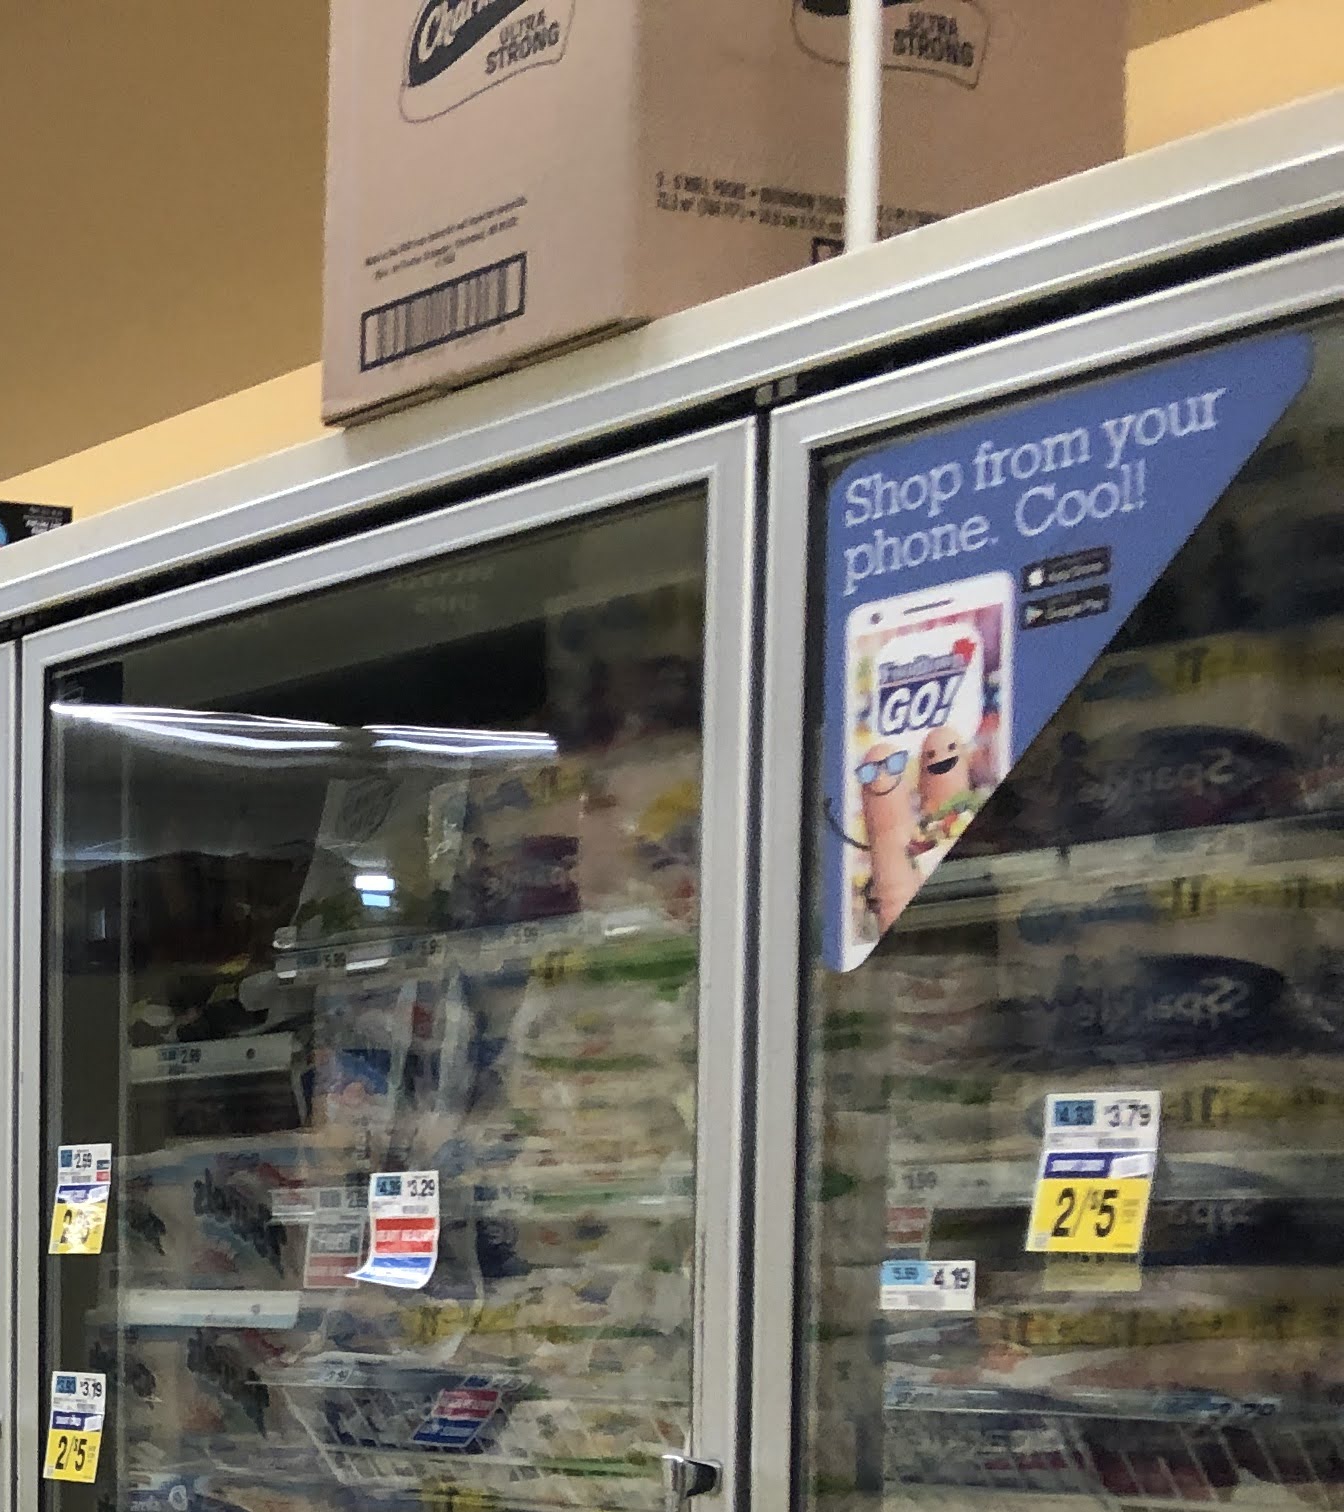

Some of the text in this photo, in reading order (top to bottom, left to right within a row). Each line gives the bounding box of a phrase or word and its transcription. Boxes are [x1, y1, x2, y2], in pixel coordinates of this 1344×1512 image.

[484, 20, 560, 75] STRONG
[843, 387, 1229, 528] Shop from your
[842, 458, 1147, 597] phone. Cool!
[880, 673, 963, 736] GO!
[55, 1435, 88, 1473] 2/$5
